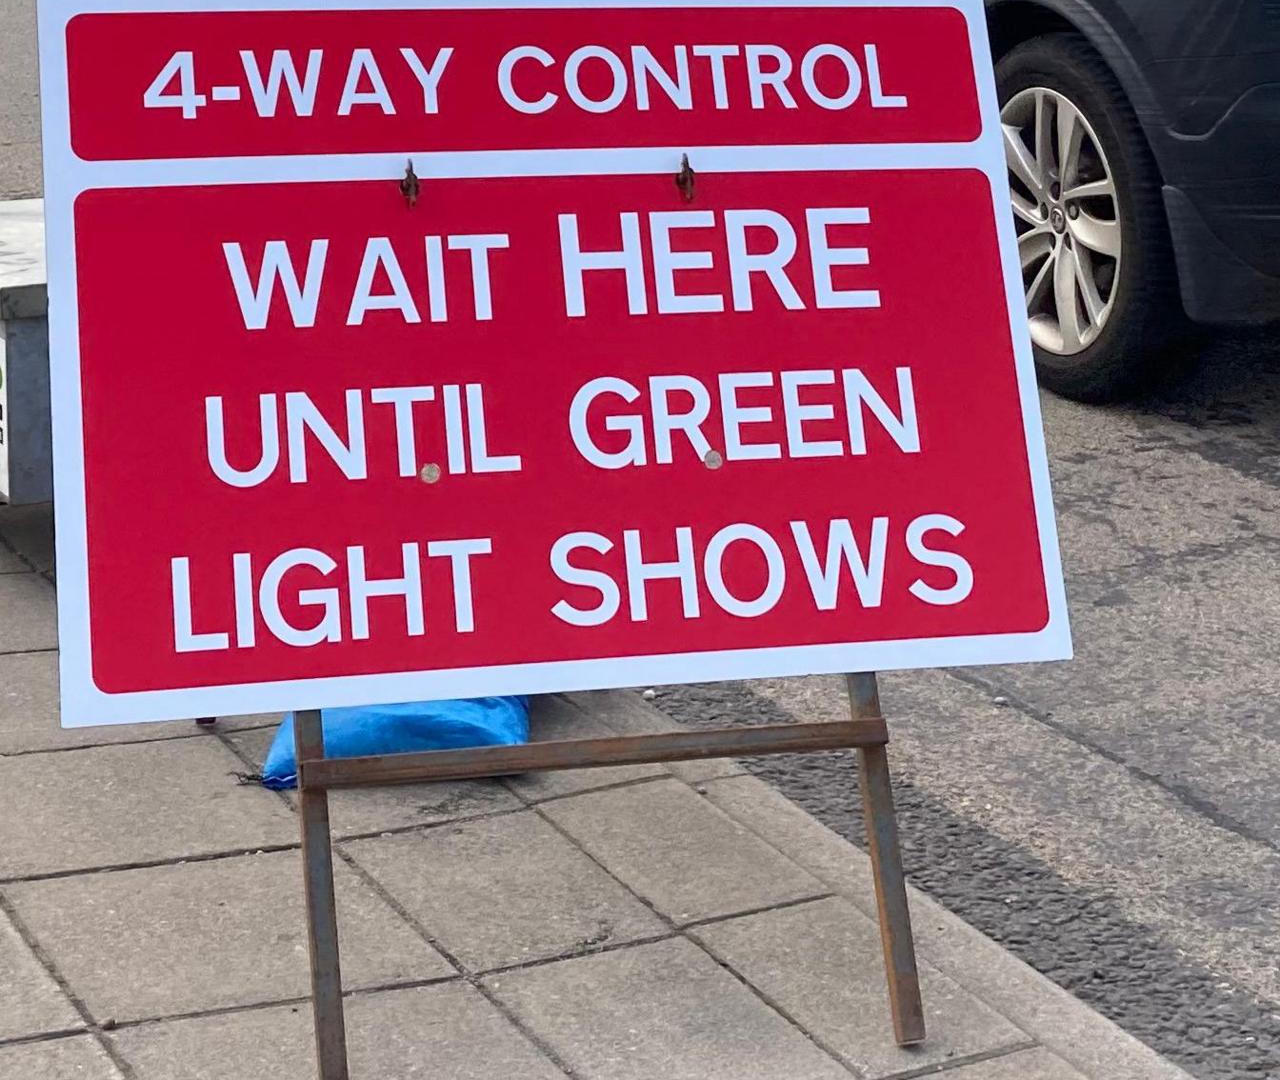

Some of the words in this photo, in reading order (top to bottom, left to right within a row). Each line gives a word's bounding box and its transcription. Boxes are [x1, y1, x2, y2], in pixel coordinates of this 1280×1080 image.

[143, 48, 454, 119] 4-WAY
[498, 44, 908, 114] CONTROL
[223, 234, 510, 330] WAIT
[558, 207, 881, 317] HERE
[206, 383, 522, 488] UNTIL
[570, 366, 921, 470] GREEN
[171, 537, 492, 653] LIGHT
[549, 513, 974, 627] SHOWS
